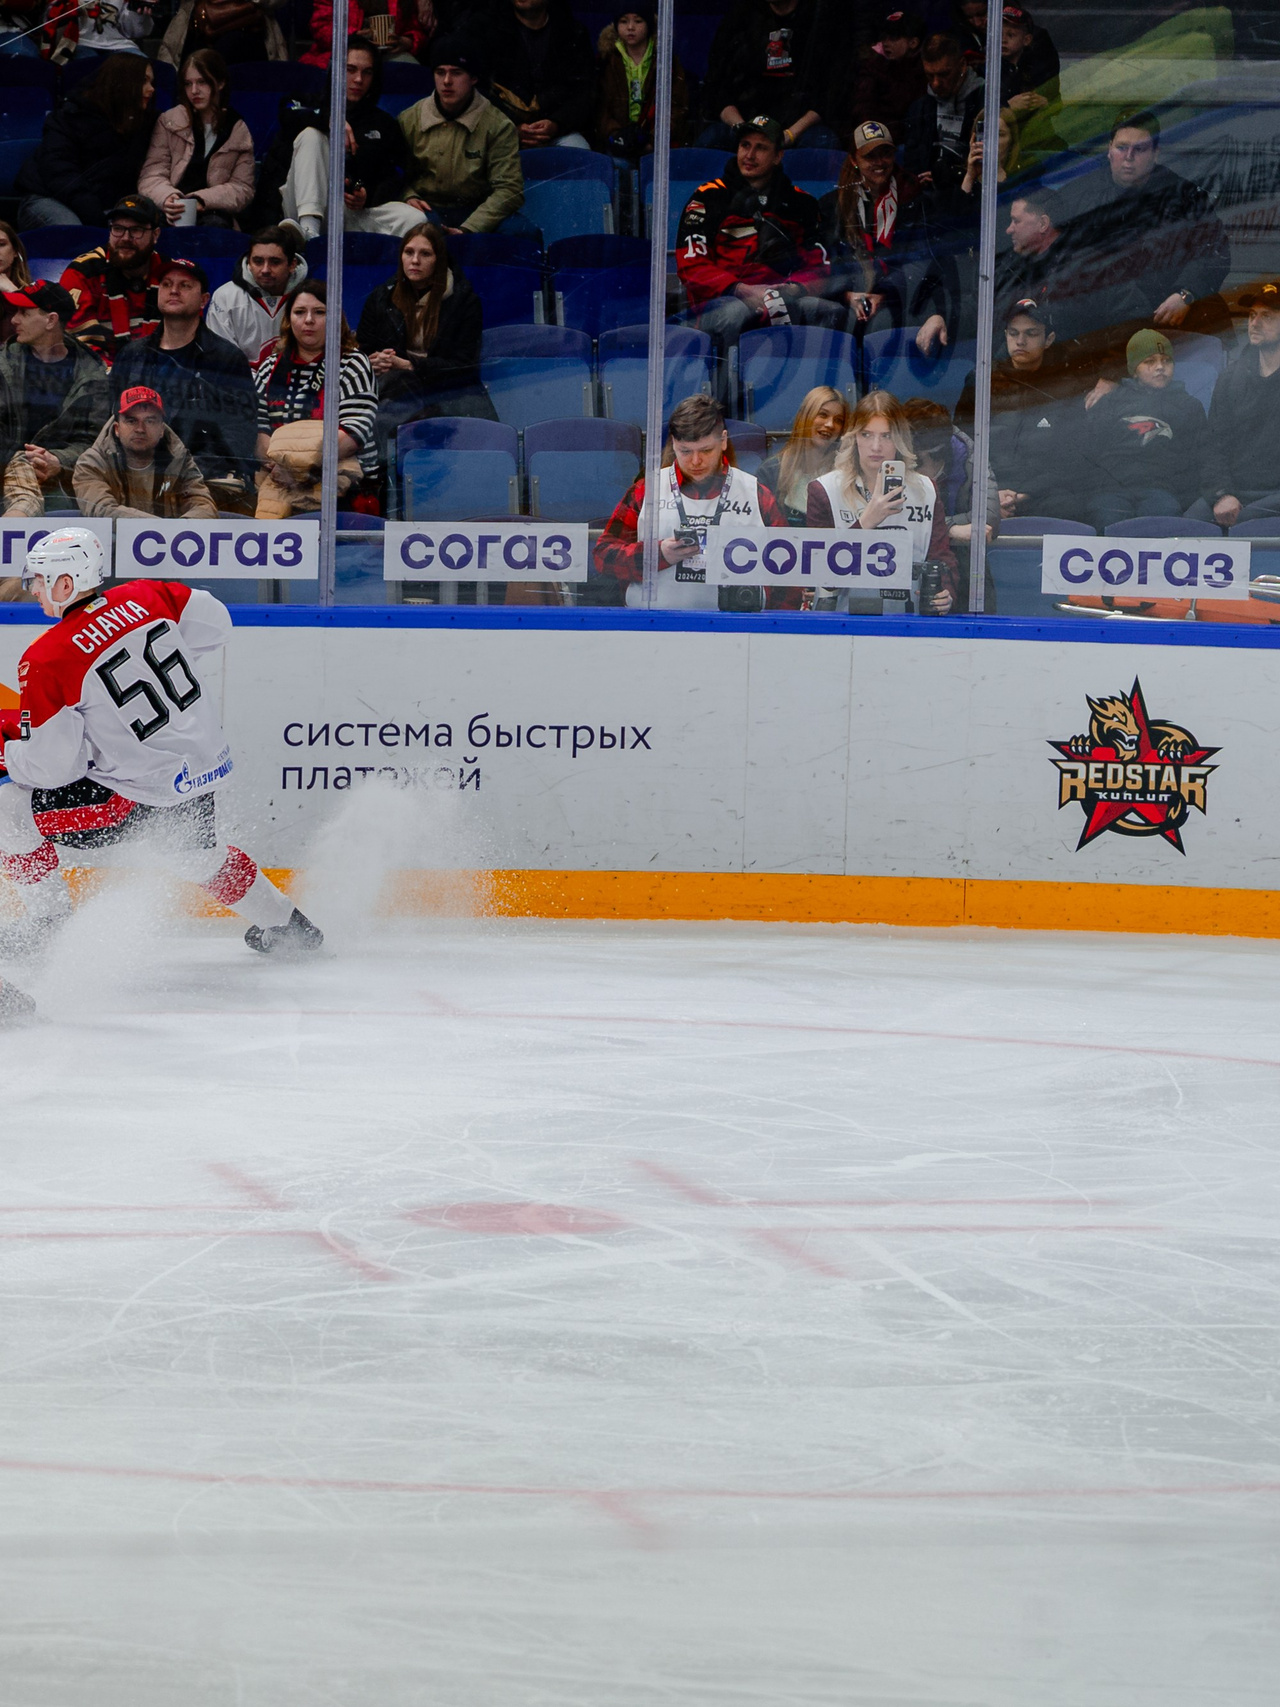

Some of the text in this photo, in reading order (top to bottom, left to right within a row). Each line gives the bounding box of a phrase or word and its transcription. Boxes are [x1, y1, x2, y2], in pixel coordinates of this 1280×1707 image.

[683, 233, 708, 259] 13
[723, 500, 752, 515] 244
[905, 505, 932, 522] 234
[132, 530, 303, 567] согаз
[400, 533, 572, 570] согаз
[723, 538, 897, 577] согаз
[1059, 548, 1234, 588] согаз
[71, 599, 150, 654] CHAYKA
[94, 620, 202, 743] 56
[283, 713, 652, 758] система быстрых
[1055, 761, 1215, 811] REDSTAR
